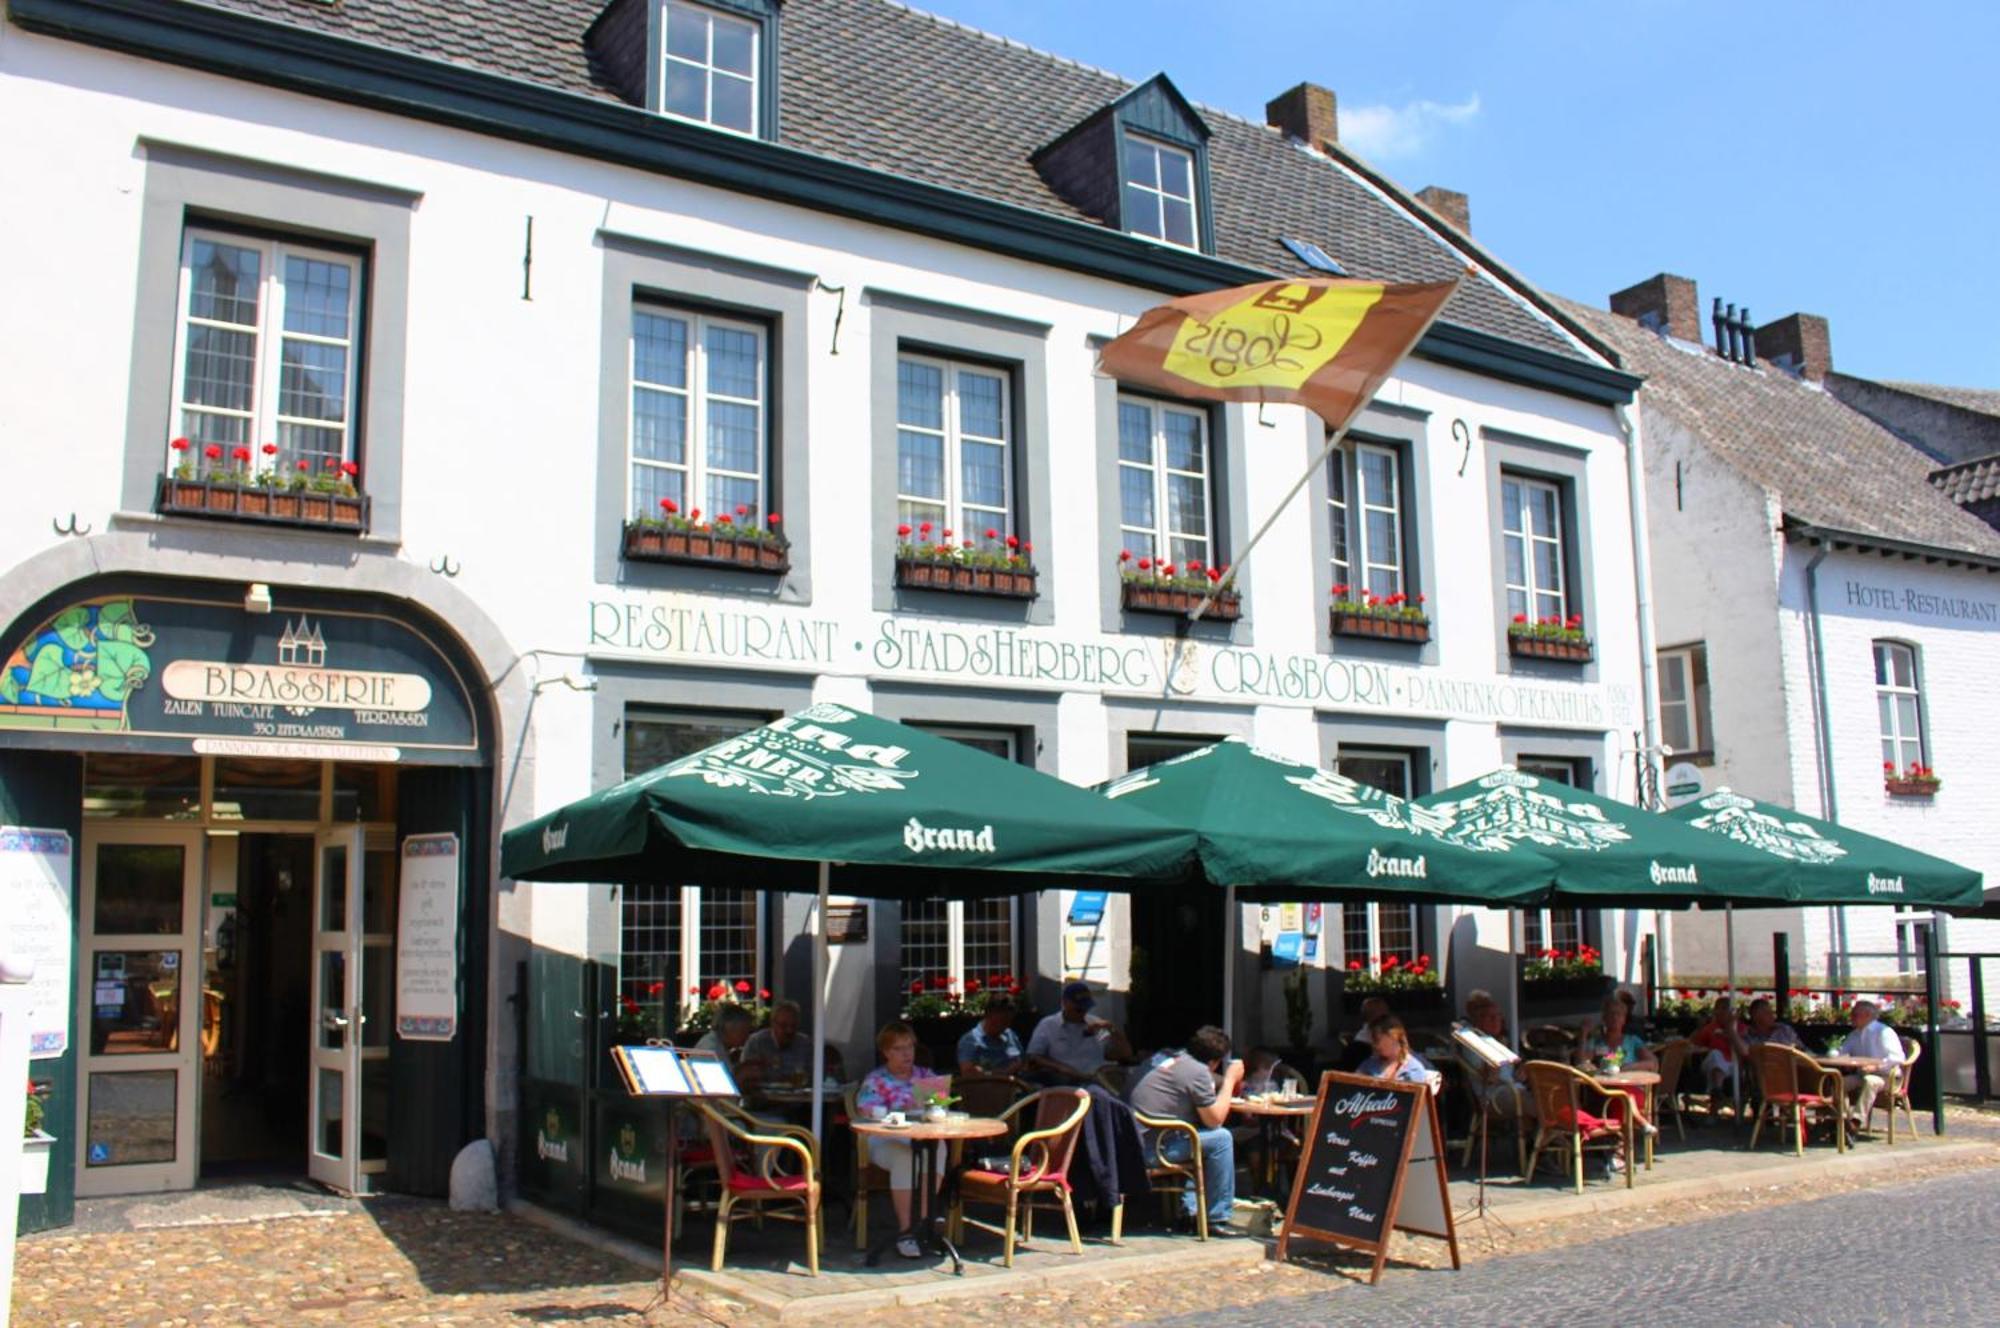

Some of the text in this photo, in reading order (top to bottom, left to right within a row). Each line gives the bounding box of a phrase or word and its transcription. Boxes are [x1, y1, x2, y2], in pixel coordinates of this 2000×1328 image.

[588, 600, 839, 663] RESTAURANT
[1211, 649, 1391, 706] CRASBORN
[1408, 676, 1602, 724] PANNENKOEKENHUIS
[204, 667, 395, 706] BRASSERIE
[164, 700, 203, 716] ZALEN
[903, 817, 996, 853] Brand
[1366, 847, 1427, 878] Brand
[1650, 860, 1698, 885] Brand
[1868, 873, 1904, 894] Brand
[1334, 1091, 1399, 1119] Alfredo
